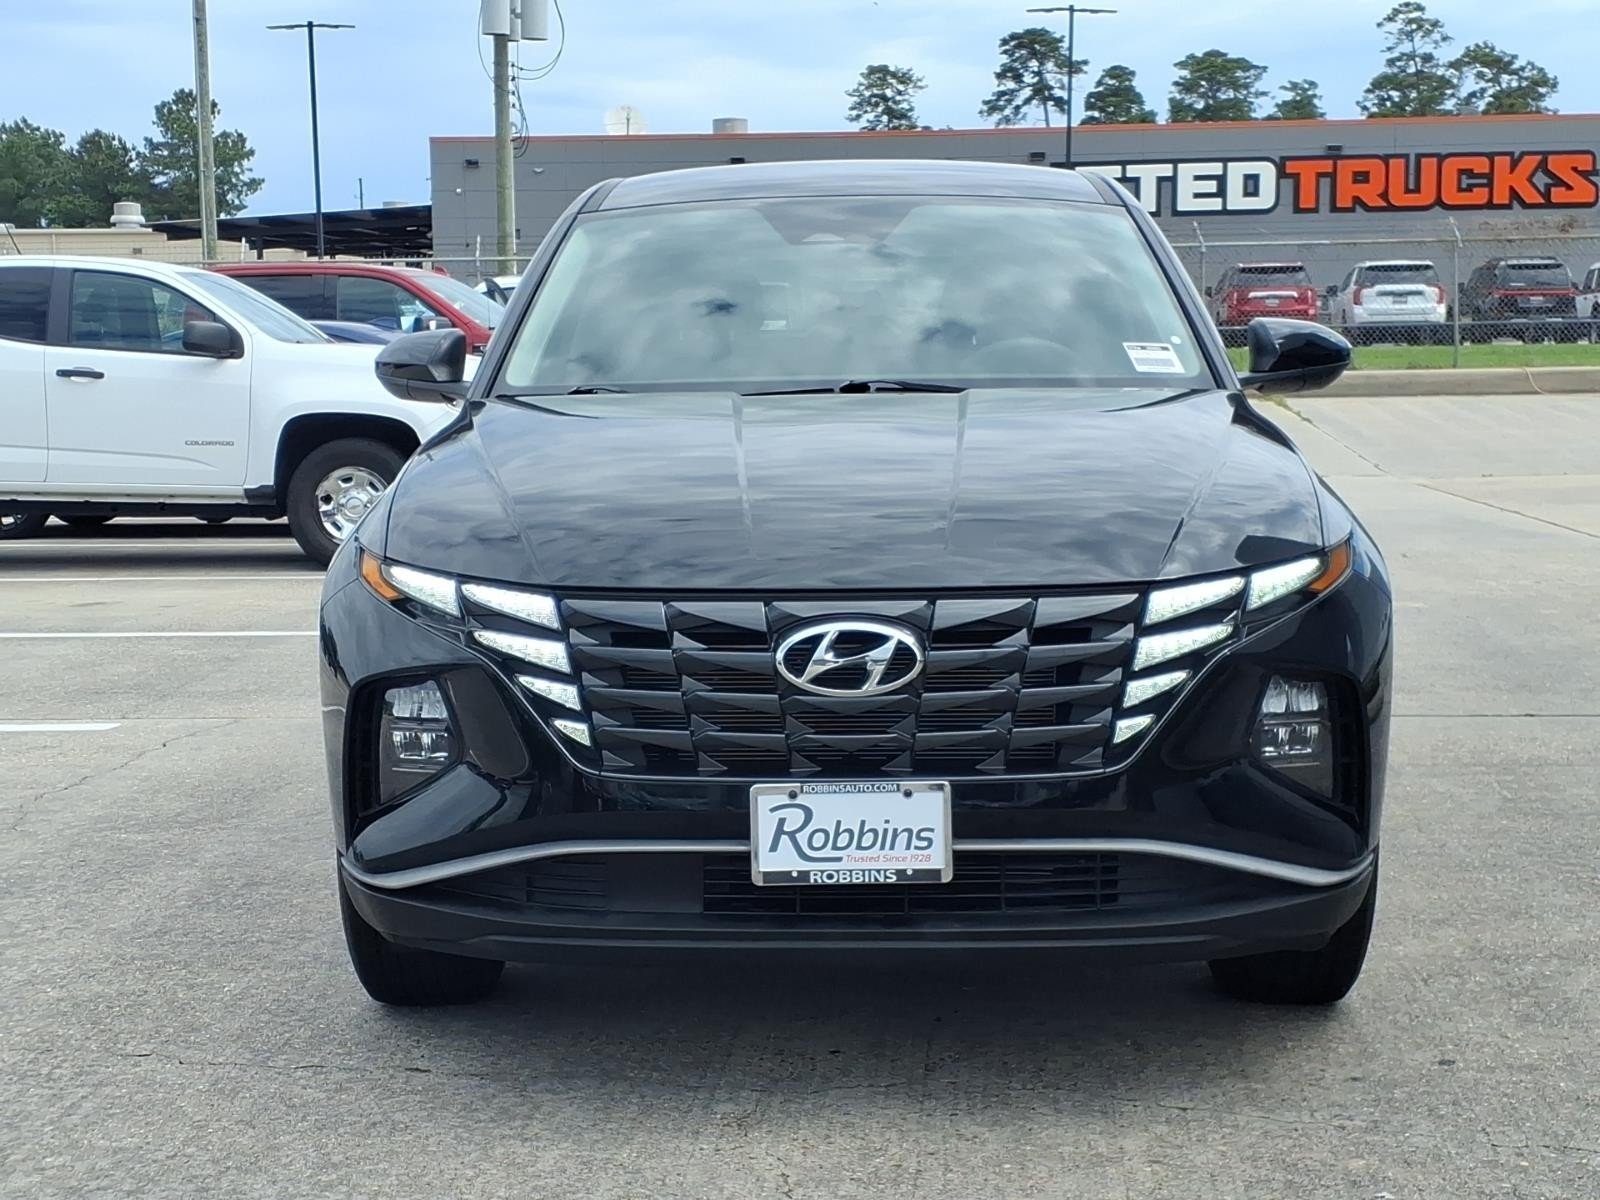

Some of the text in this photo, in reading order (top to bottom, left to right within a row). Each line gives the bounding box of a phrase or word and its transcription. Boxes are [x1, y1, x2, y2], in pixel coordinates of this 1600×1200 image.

[1075, 153, 1597, 213] TED TRUCKS
[802, 783, 898, 794] ROBBINSAUTO.COM
[768, 802, 936, 863] Robbins
[846, 854, 932, 863] Trusted Since 1928
[809, 869, 898, 884] ROBBINS
